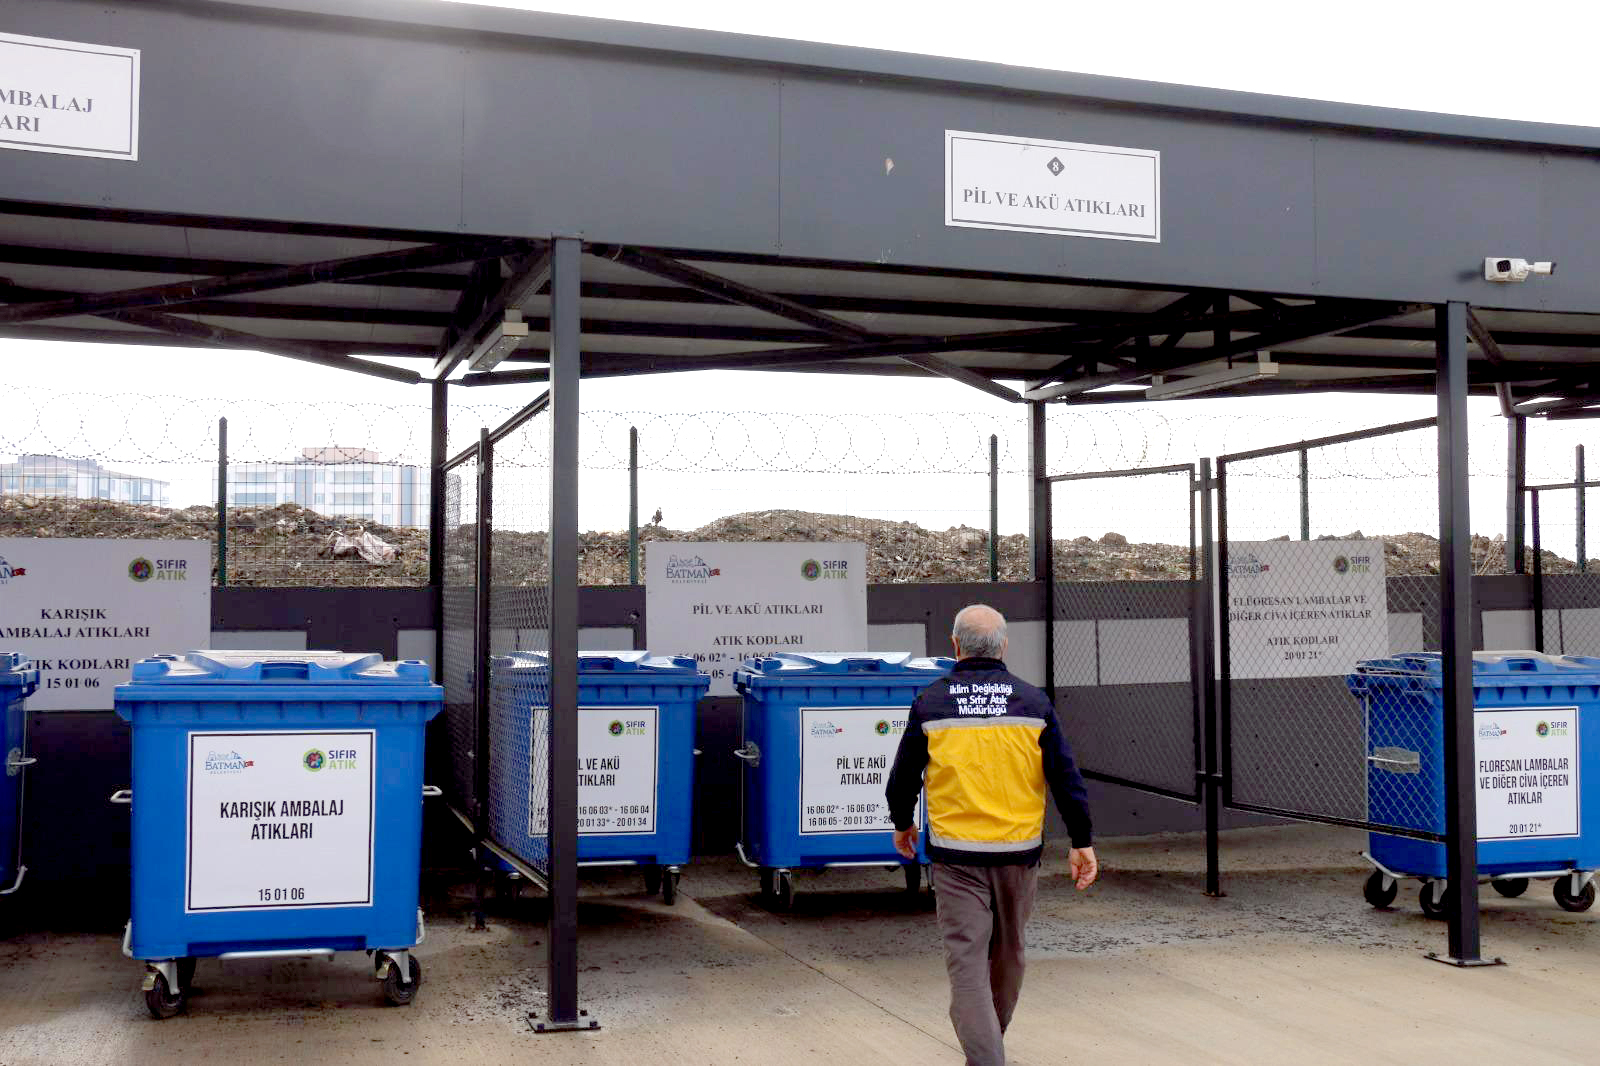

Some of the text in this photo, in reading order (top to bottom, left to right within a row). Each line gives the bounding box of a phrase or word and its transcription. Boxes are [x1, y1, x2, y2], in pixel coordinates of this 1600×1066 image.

[1052, 161, 1060, 172] 8
[963, 187, 1146, 218] PİL VE AKÜ ATIKLARI
[156, 559, 188, 570] SIFIR
[823, 560, 848, 570] SIFIR
[156, 570, 188, 581] ATIK
[666, 566, 711, 578] BATMAN
[823, 571, 848, 580] ATIK
[1353, 594, 1368, 604] VE
[692, 602, 824, 614] PİL VE AKÜ ATIKLARI
[41, 608, 108, 621] KARIŞIK
[1330, 609, 1372, 619] ATIKLAR
[75, 627, 150, 638] ATIKLARI
[712, 635, 804, 646] ATIK KODLARI
[1267, 636, 1338, 646] ATIK KODLARI
[27, 658, 130, 670] TIK KODLARI
[47, 678, 100, 688] 15 01 06
[972, 683, 1013, 696] Değişikliği
[957, 697, 967, 705] ve
[958, 704, 1007, 716] Müdürlüğü
[625, 720, 646, 728] SIFIR
[892, 720, 908, 728] SIFI
[1551, 721, 1568, 729] SIFIR
[625, 728, 646, 736] ATIK
[328, 749, 357, 760] SIFIR
[205, 760, 246, 771] BATMAN
[328, 760, 357, 770] ATIK
[586, 758, 598, 770] VE
[600, 755, 620, 770] AKÜ
[836, 755, 886, 769] PİL VE AKÜ
[1480, 758, 1569, 772] FLORESAN LAMBALAR
[577, 774, 615, 786] TIKLARI
[840, 773, 882, 785] ATIKLARI
[1480, 772, 1569, 789] VE DİĞER CİVA İÇEREN
[1508, 792, 1543, 805] ATIKLAR
[220, 799, 344, 821] KARIŞIK AMBALAJ
[579, 806, 587, 815] 16
[589, 806, 598, 815] 06
[620, 805, 629, 814] 16
[630, 805, 639, 814] 06
[640, 805, 650, 813] 04
[616, 818, 626, 827] 20
[637, 817, 647, 826] 34
[251, 822, 313, 841] ATIKLARI
[1509, 824, 1518, 833] 20
[1520, 823, 1528, 833] 01
[258, 887, 305, 901] 15 01 06
